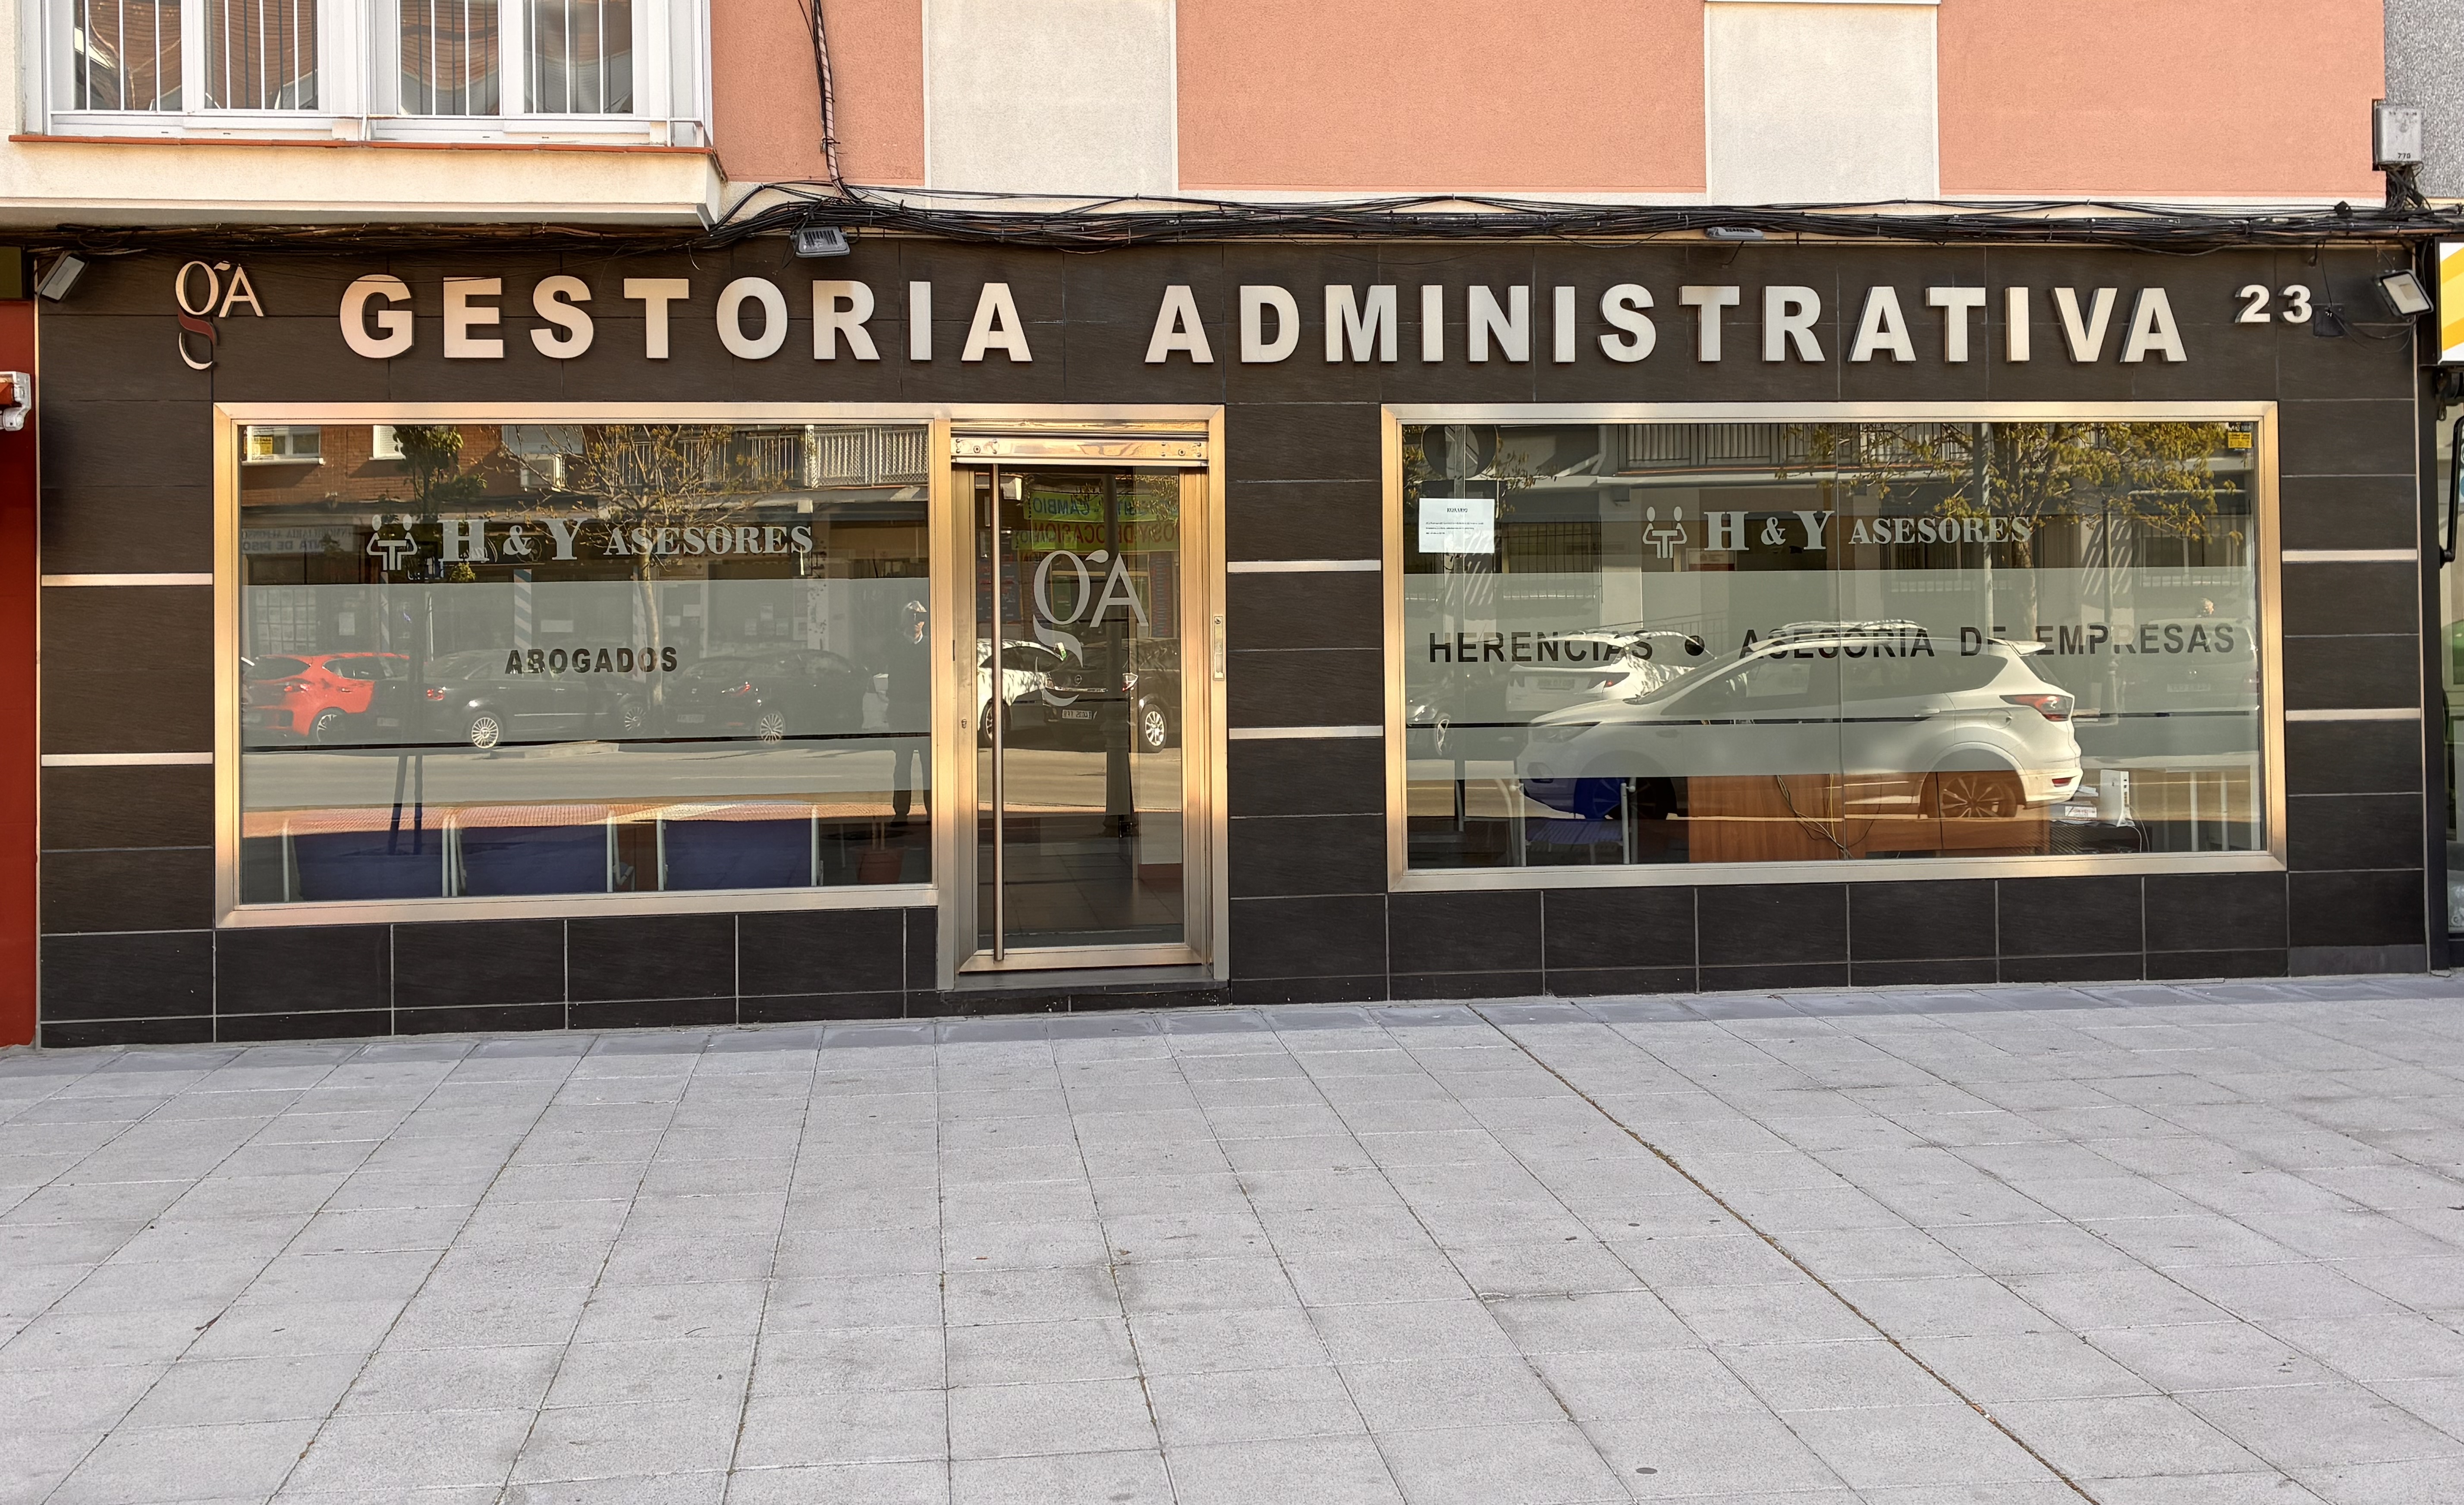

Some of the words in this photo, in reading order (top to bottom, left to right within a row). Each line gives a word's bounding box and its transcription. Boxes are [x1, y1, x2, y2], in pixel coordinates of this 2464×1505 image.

[339, 273, 1033, 362] GESTORIA
[1144, 284, 2188, 364] ADMINISTRATIVA
[2235, 284, 2313, 324] 23
[437, 518, 490, 562] H
[503, 525, 532, 555] &
[540, 518, 588, 560] Y
[603, 525, 813, 556] ASESORES
[1704, 510, 1750, 552] H
[1760, 516, 1786, 546] &
[1793, 510, 1835, 550] Y
[1848, 515, 2033, 544] ASESORES
[505, 647, 678, 675] ABOGADOS
[1429, 629, 1653, 663] HERENCIAS
[2035, 622, 2235, 656] EMPRESAS
